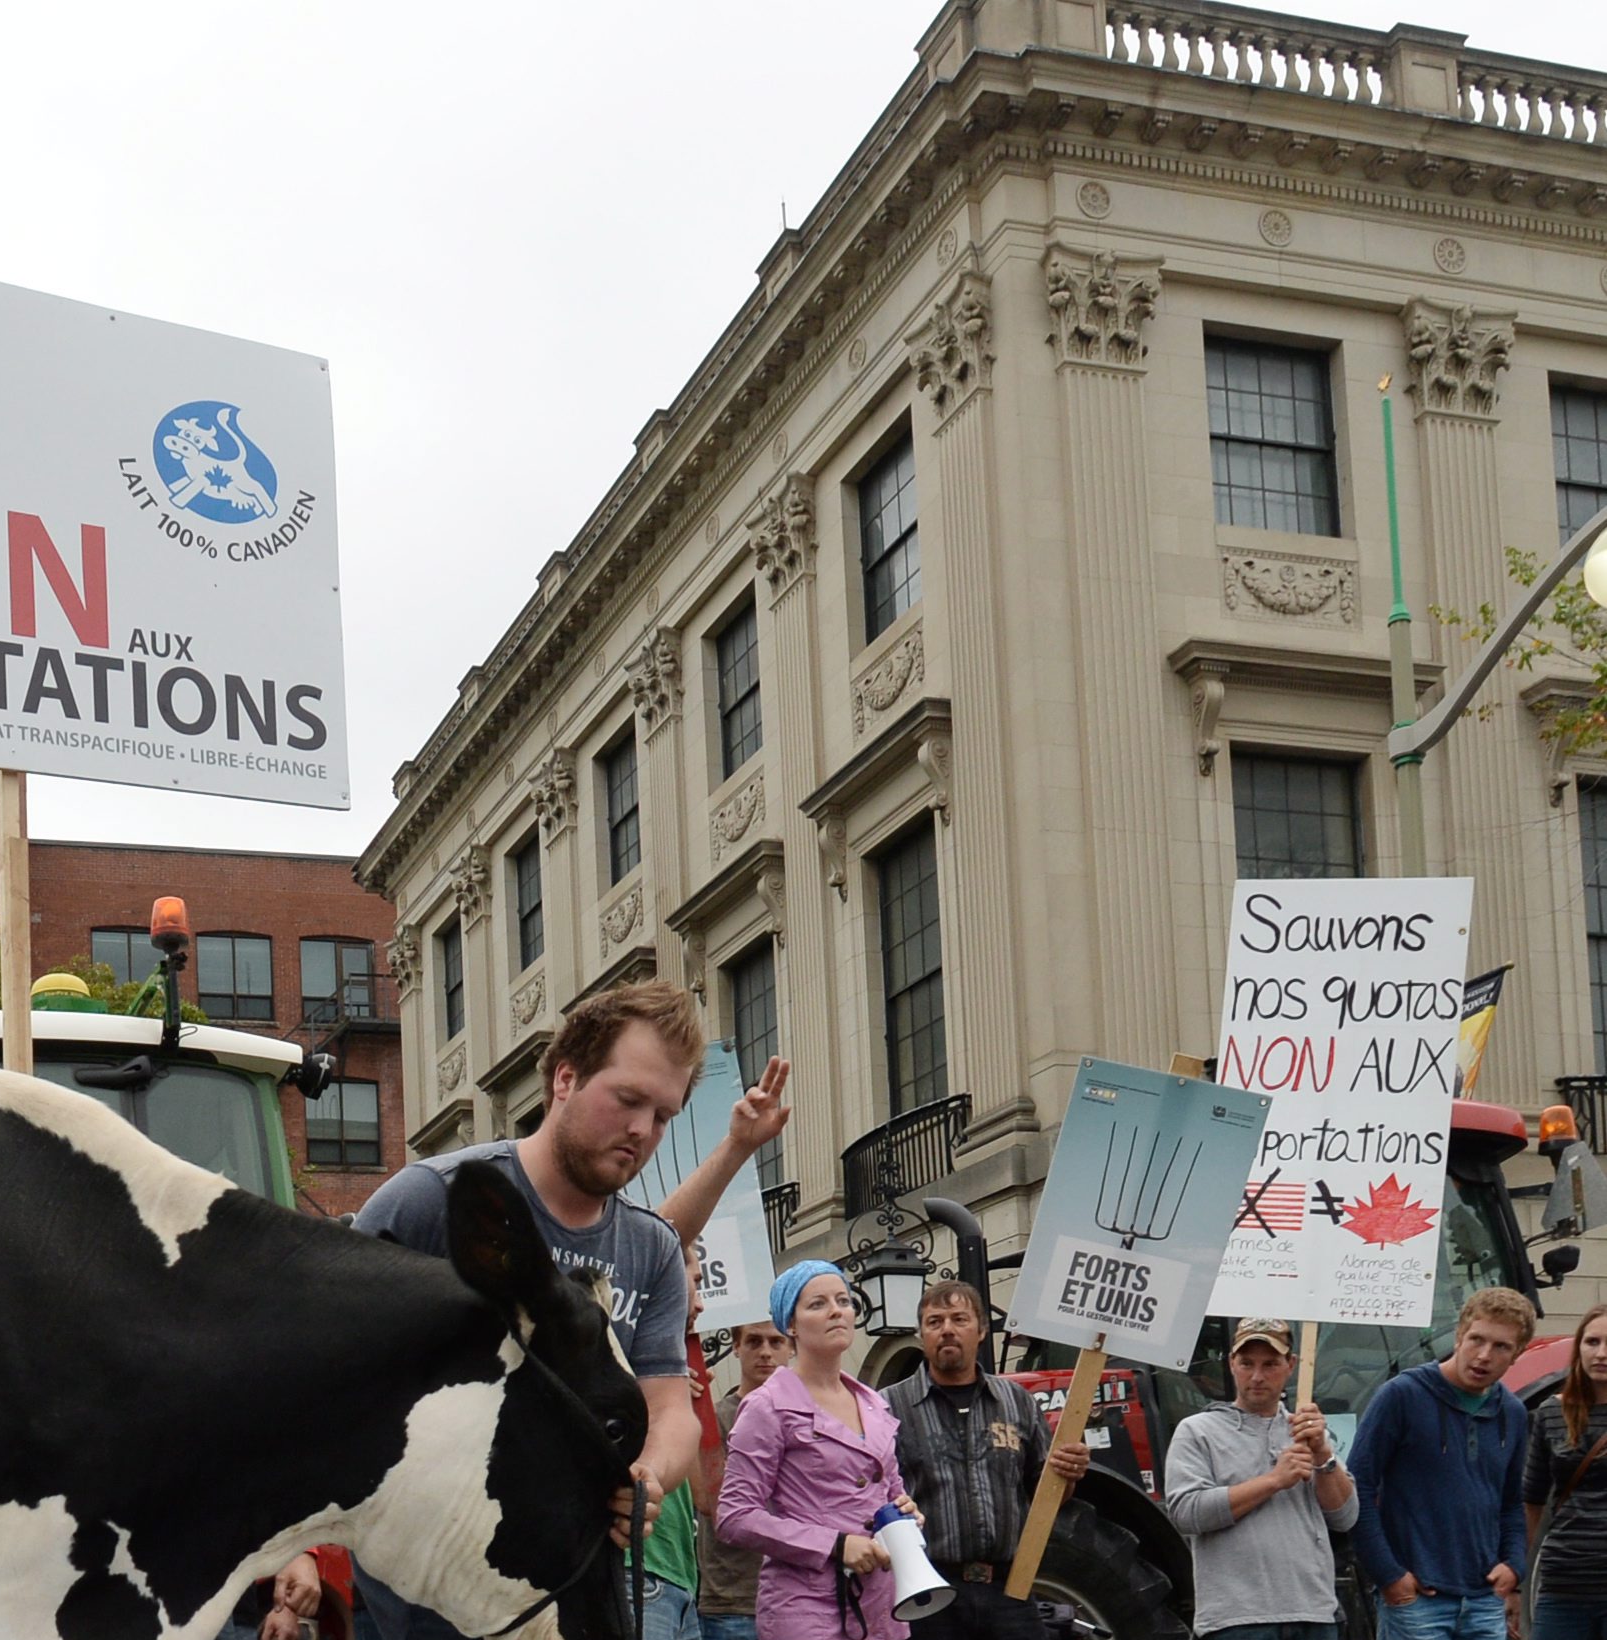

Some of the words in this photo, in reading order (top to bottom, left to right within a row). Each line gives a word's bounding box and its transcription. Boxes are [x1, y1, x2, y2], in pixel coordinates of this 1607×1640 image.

[118, 457, 158, 511] LAIT
[156, 512, 218, 559] 100%
[226, 489, 316, 562] CANADIEN
[128, 627, 194, 662] AUX
[18, 725, 175, 761] TRANSPACIFIQUE
[190, 748, 328, 780] LIBRE-ÉCHANGE
[1240, 893, 1434, 954] Sauvons
[1231, 975, 1308, 1022] nos
[1322, 975, 1462, 1030] quotas
[1220, 1034, 1335, 1093] NON
[1349, 1036, 1454, 1094] AUX
[1068, 1250, 1151, 1292] FORTS
[1340, 1253, 1396, 1271] Normes
[1401, 1256, 1423, 1272] de
[1060, 1278, 1095, 1308] ET
[1095, 1286, 1158, 1323] UNIS
[1076, 1307, 1085, 1317] LA
[1086, 1310, 1113, 1324] GESTION
[1033, 1383, 1102, 1412] CAE
